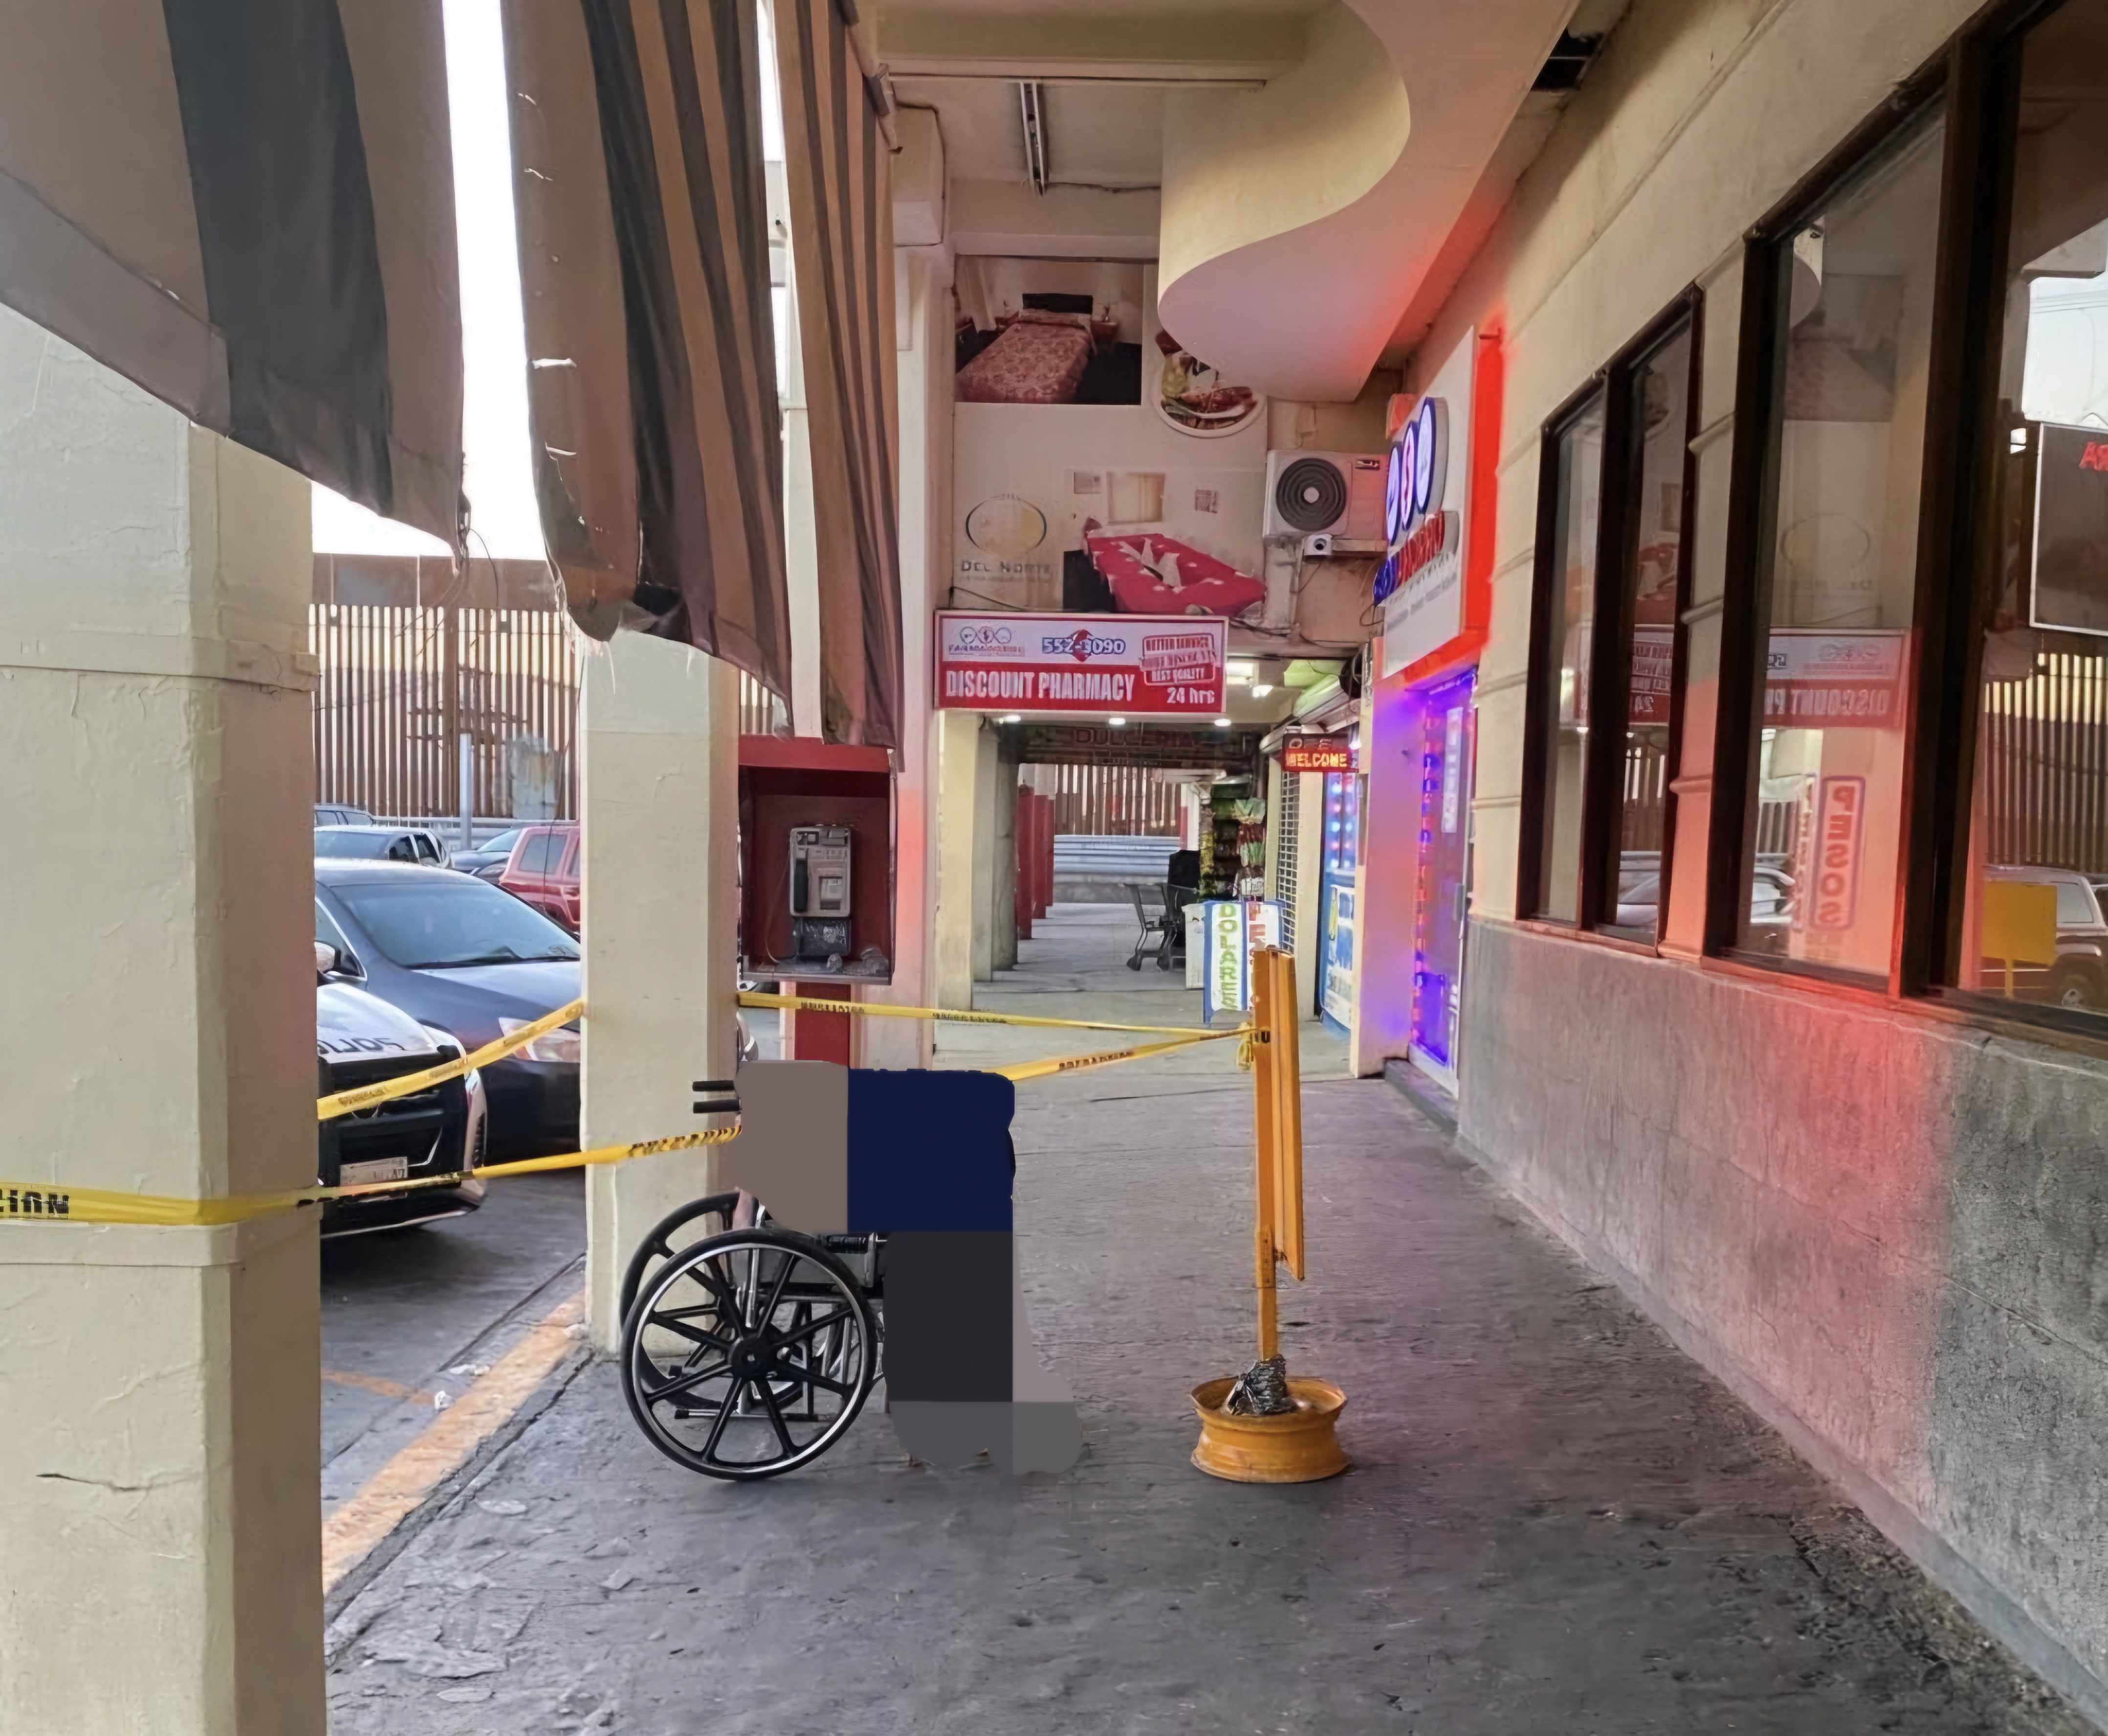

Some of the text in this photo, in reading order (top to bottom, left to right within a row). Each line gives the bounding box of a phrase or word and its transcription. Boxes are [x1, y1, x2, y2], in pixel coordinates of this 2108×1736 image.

[946, 670, 1135, 702] DISCOUNT PHARMACY
[1285, 753, 1348, 767] WELCOME
[0, 1189, 70, 1214] ION
